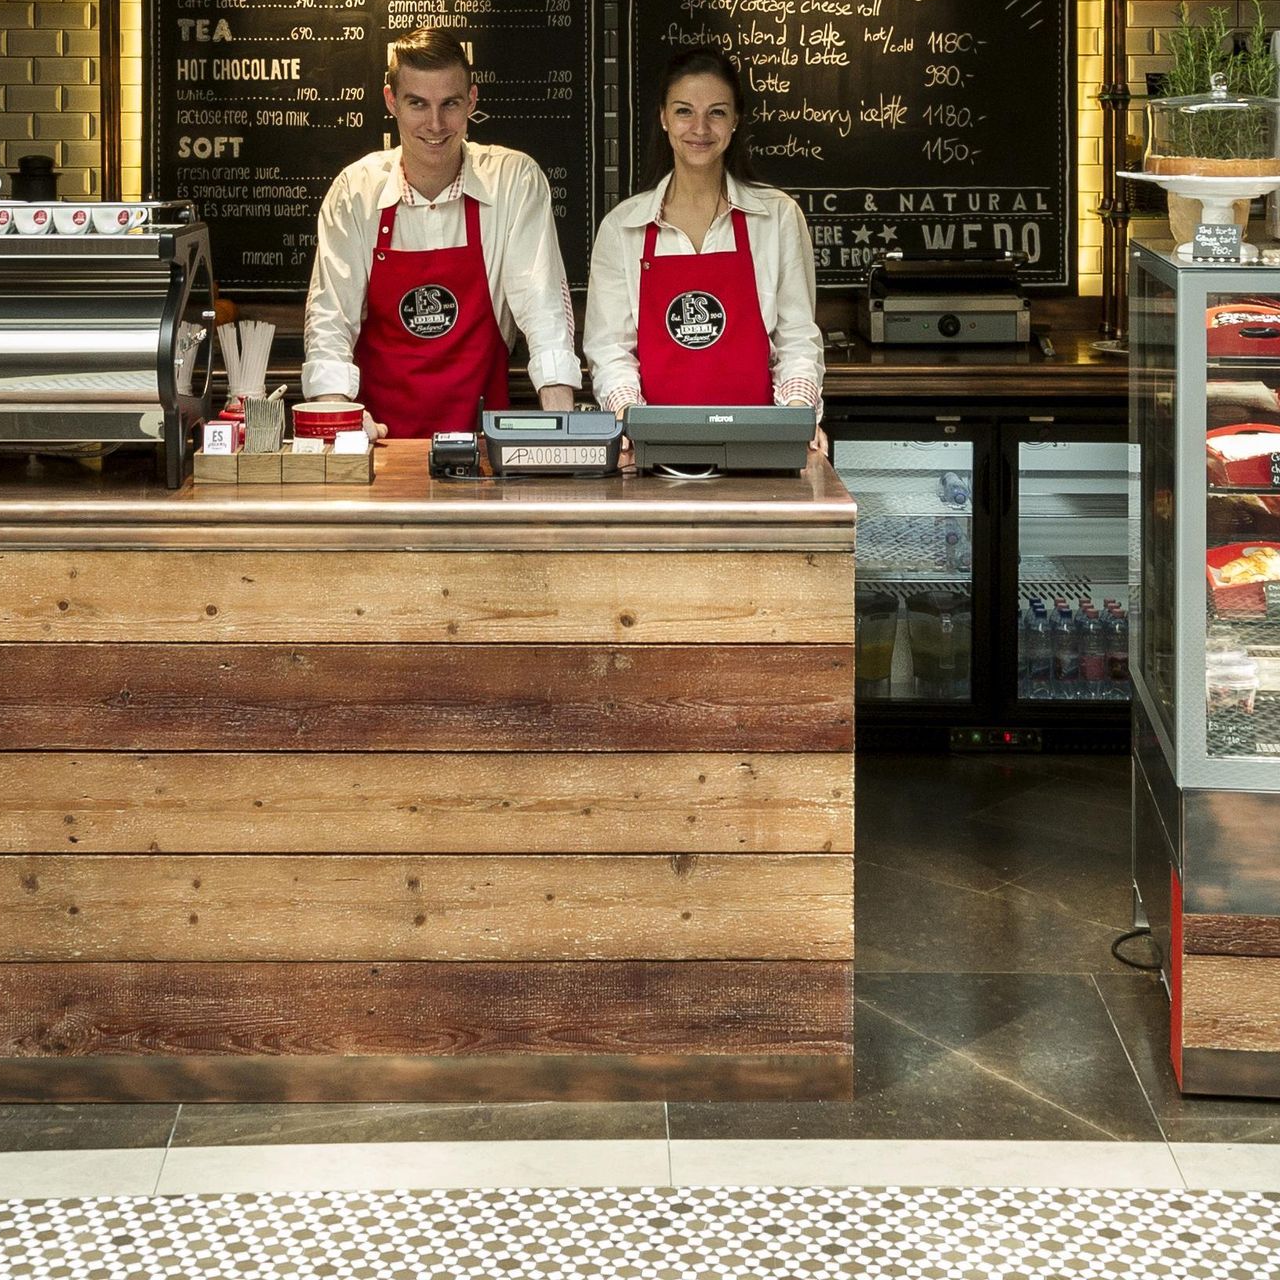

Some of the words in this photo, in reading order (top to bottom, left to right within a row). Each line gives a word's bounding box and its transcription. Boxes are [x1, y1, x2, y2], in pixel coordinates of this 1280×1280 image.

[545, 0, 570, 12] 1280
[547, 15, 571, 27] 1480
[177, 18, 232, 43] TEA
[291, 27, 313, 41] 690
[343, 27, 365, 40] 750
[669, 22, 733, 51] floating
[738, 20, 787, 45] island
[177, 59, 207, 82] HOT
[212, 58, 301, 80] CHOCOLATE
[547, 70, 572, 83] 1280
[297, 88, 318, 101] 1190
[340, 88, 364, 101] 1290
[547, 88, 572, 100] 1280
[178, 136, 244, 159] SOFT
[864, 194, 878, 212] &
[899, 192, 1047, 212] NATURAL
[243, 251, 283, 265] minden
[709, 414, 733, 422] micros
